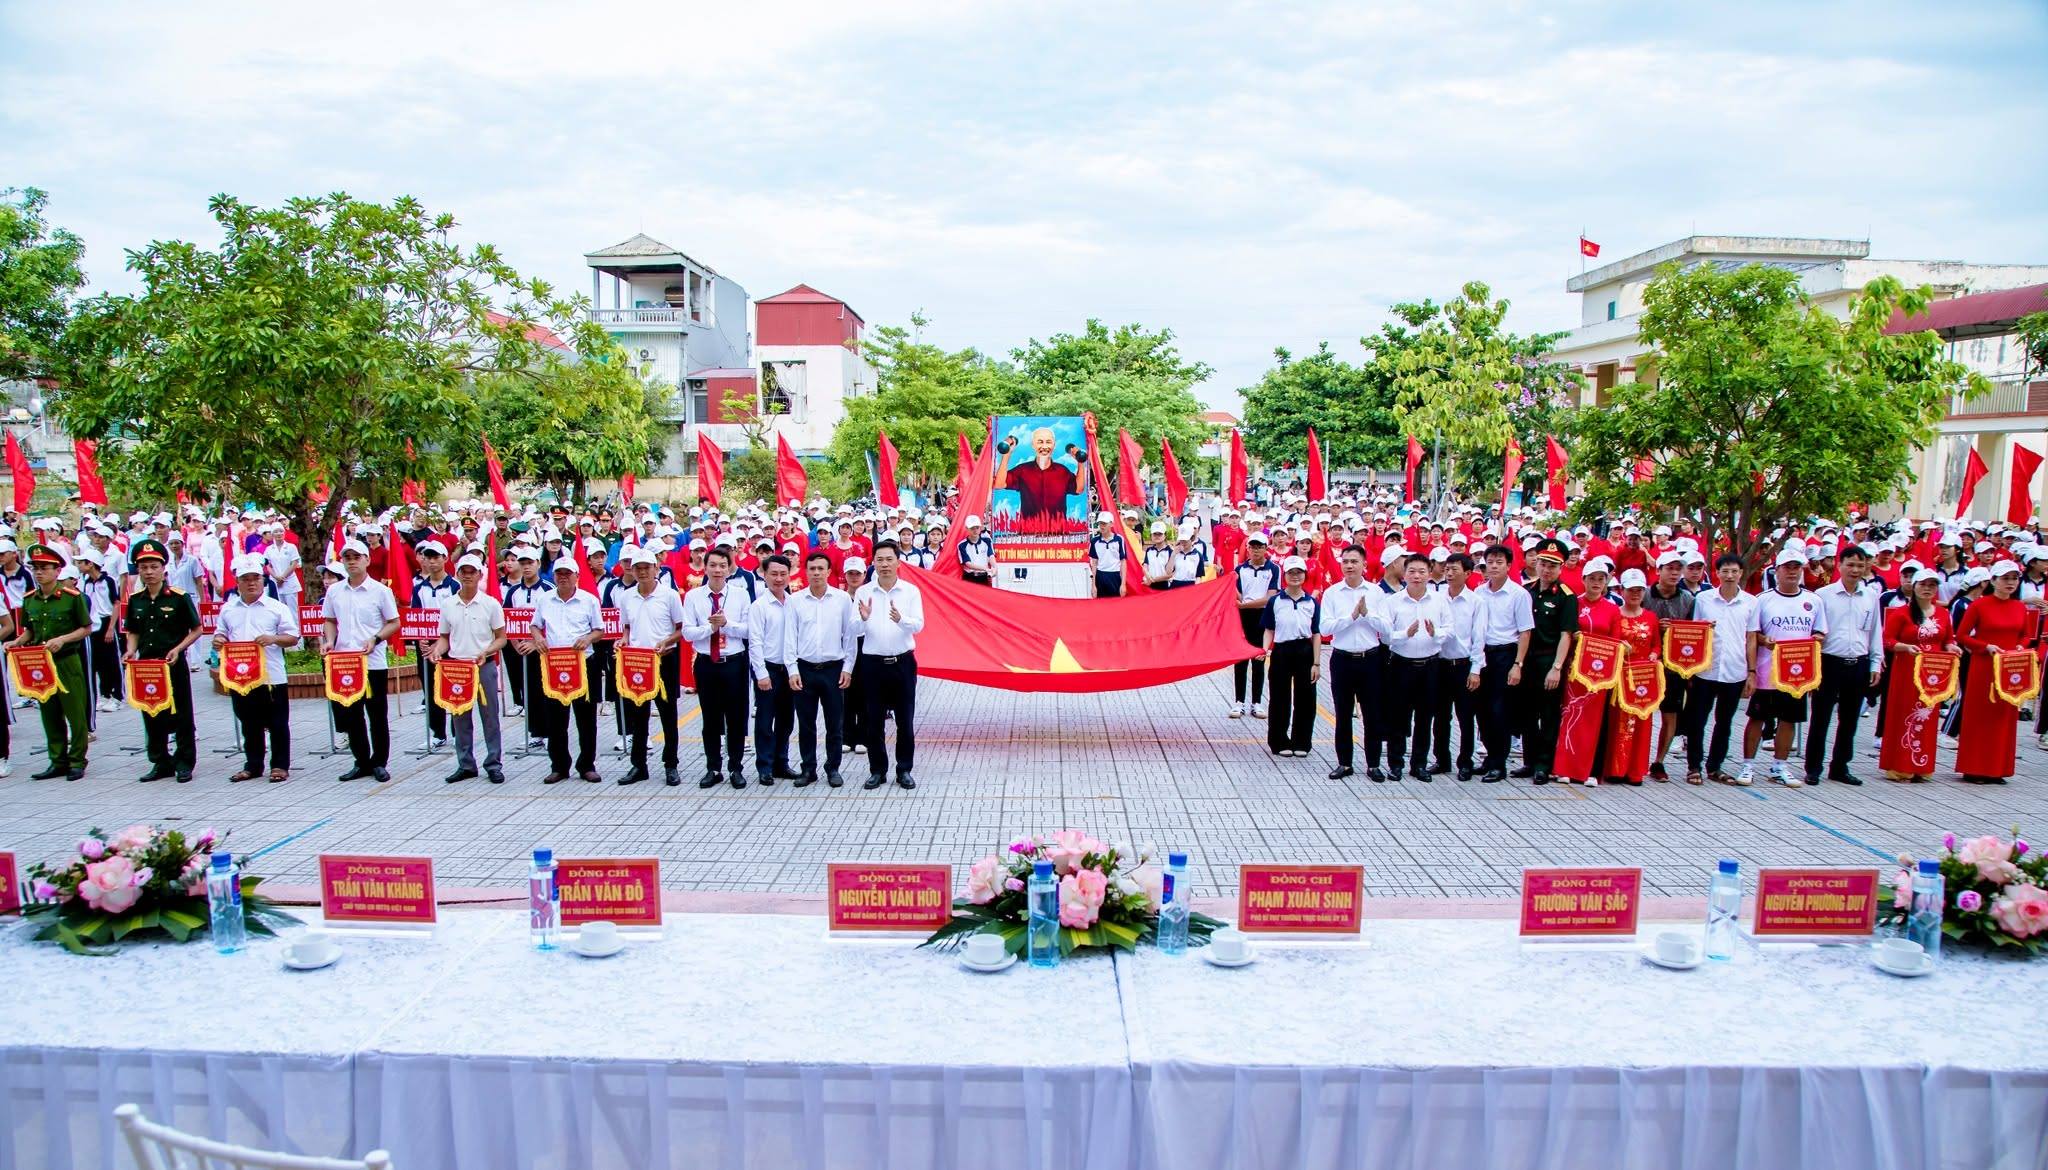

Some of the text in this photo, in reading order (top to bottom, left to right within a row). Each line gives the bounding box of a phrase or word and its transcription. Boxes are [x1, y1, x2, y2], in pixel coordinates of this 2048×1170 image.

[1772, 616, 1811, 627] QATAR
[362, 879, 385, 898] VĂN
[595, 882, 622, 901] VĂN
[838, 884, 886, 906] NGUYỄN
[890, 887, 914, 906] VĂN
[1248, 888, 1352, 912] PHẠM XUÂN SINH
[1580, 892, 1603, 911] VĂN
[1765, 889, 1805, 911] NGUYỄN
[1846, 895, 1867, 911] DUY
